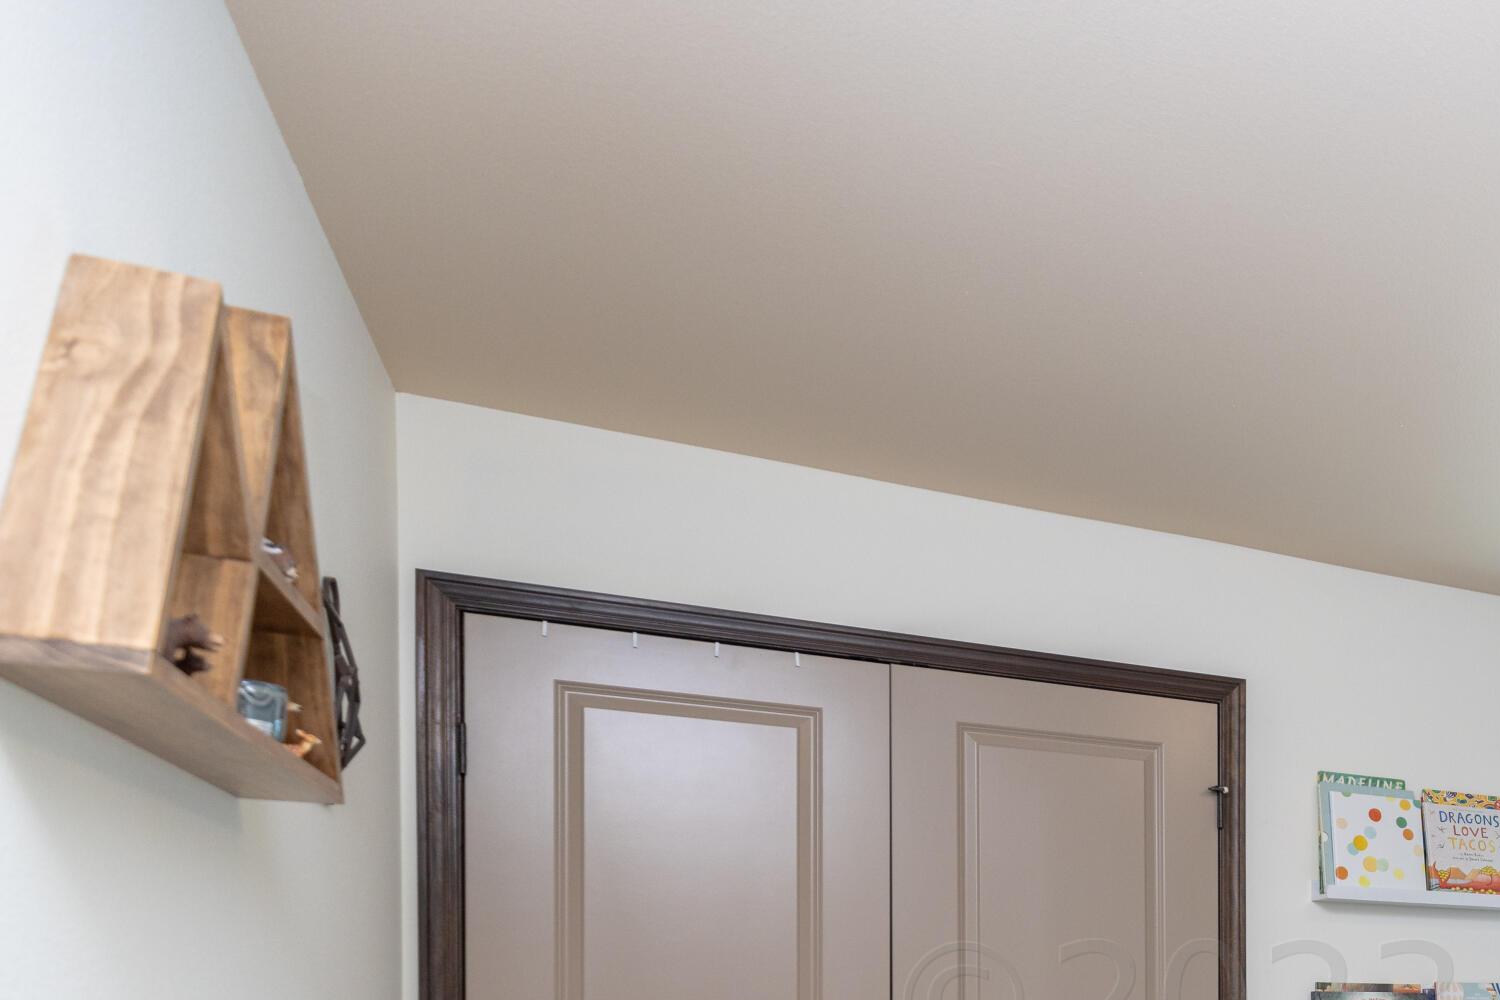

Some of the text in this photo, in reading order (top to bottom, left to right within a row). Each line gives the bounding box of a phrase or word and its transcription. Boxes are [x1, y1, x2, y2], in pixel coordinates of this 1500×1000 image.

[1322, 772, 1404, 790] MADELINE
[1439, 810, 1500, 828] DRAGONS
[1453, 825, 1489, 839] LOVE
[1448, 836, 1497, 853] TACOS
